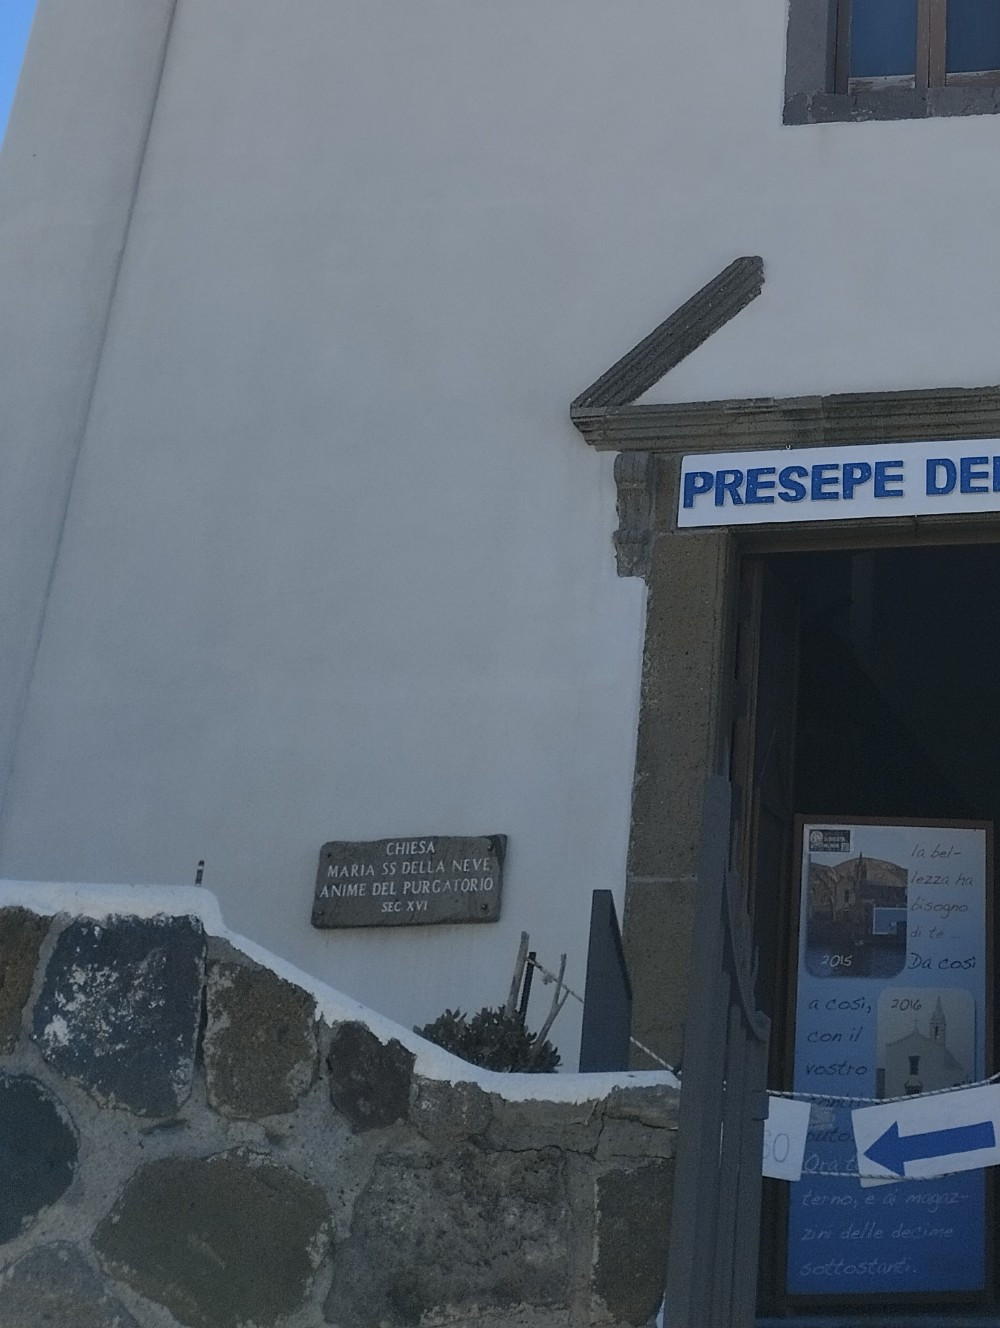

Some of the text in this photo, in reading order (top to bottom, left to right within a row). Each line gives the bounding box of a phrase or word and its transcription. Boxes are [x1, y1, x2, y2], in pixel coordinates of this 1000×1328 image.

[683, 460, 904, 508] PRESEPE
[386, 840, 435, 856] CHIESA
[911, 844, 961, 859] la bel-
[328, 857, 490, 878] MARIA SS DELLA NEVE
[910, 871, 973, 886] lezza ha
[320, 877, 494, 898] ANIME DEL PURGATORIO
[381, 900, 428, 913] SEC XVI
[910, 896, 969, 919] bisogno
[910, 926, 921, 938] di
[929, 927, 944, 939] te
[820, 954, 853, 968] 2015
[907, 952, 931, 970] Da
[808, 999, 818, 1010] a
[890, 998, 923, 1011] 2016
[807, 1026, 863, 1043] con il
[806, 1059, 868, 1076] vostro
[865, 1195, 875, 1205] e
[841, 1222, 882, 1239] delle
[891, 1223, 954, 1239] decime
[800, 1257, 918, 1276] sottostanti.
